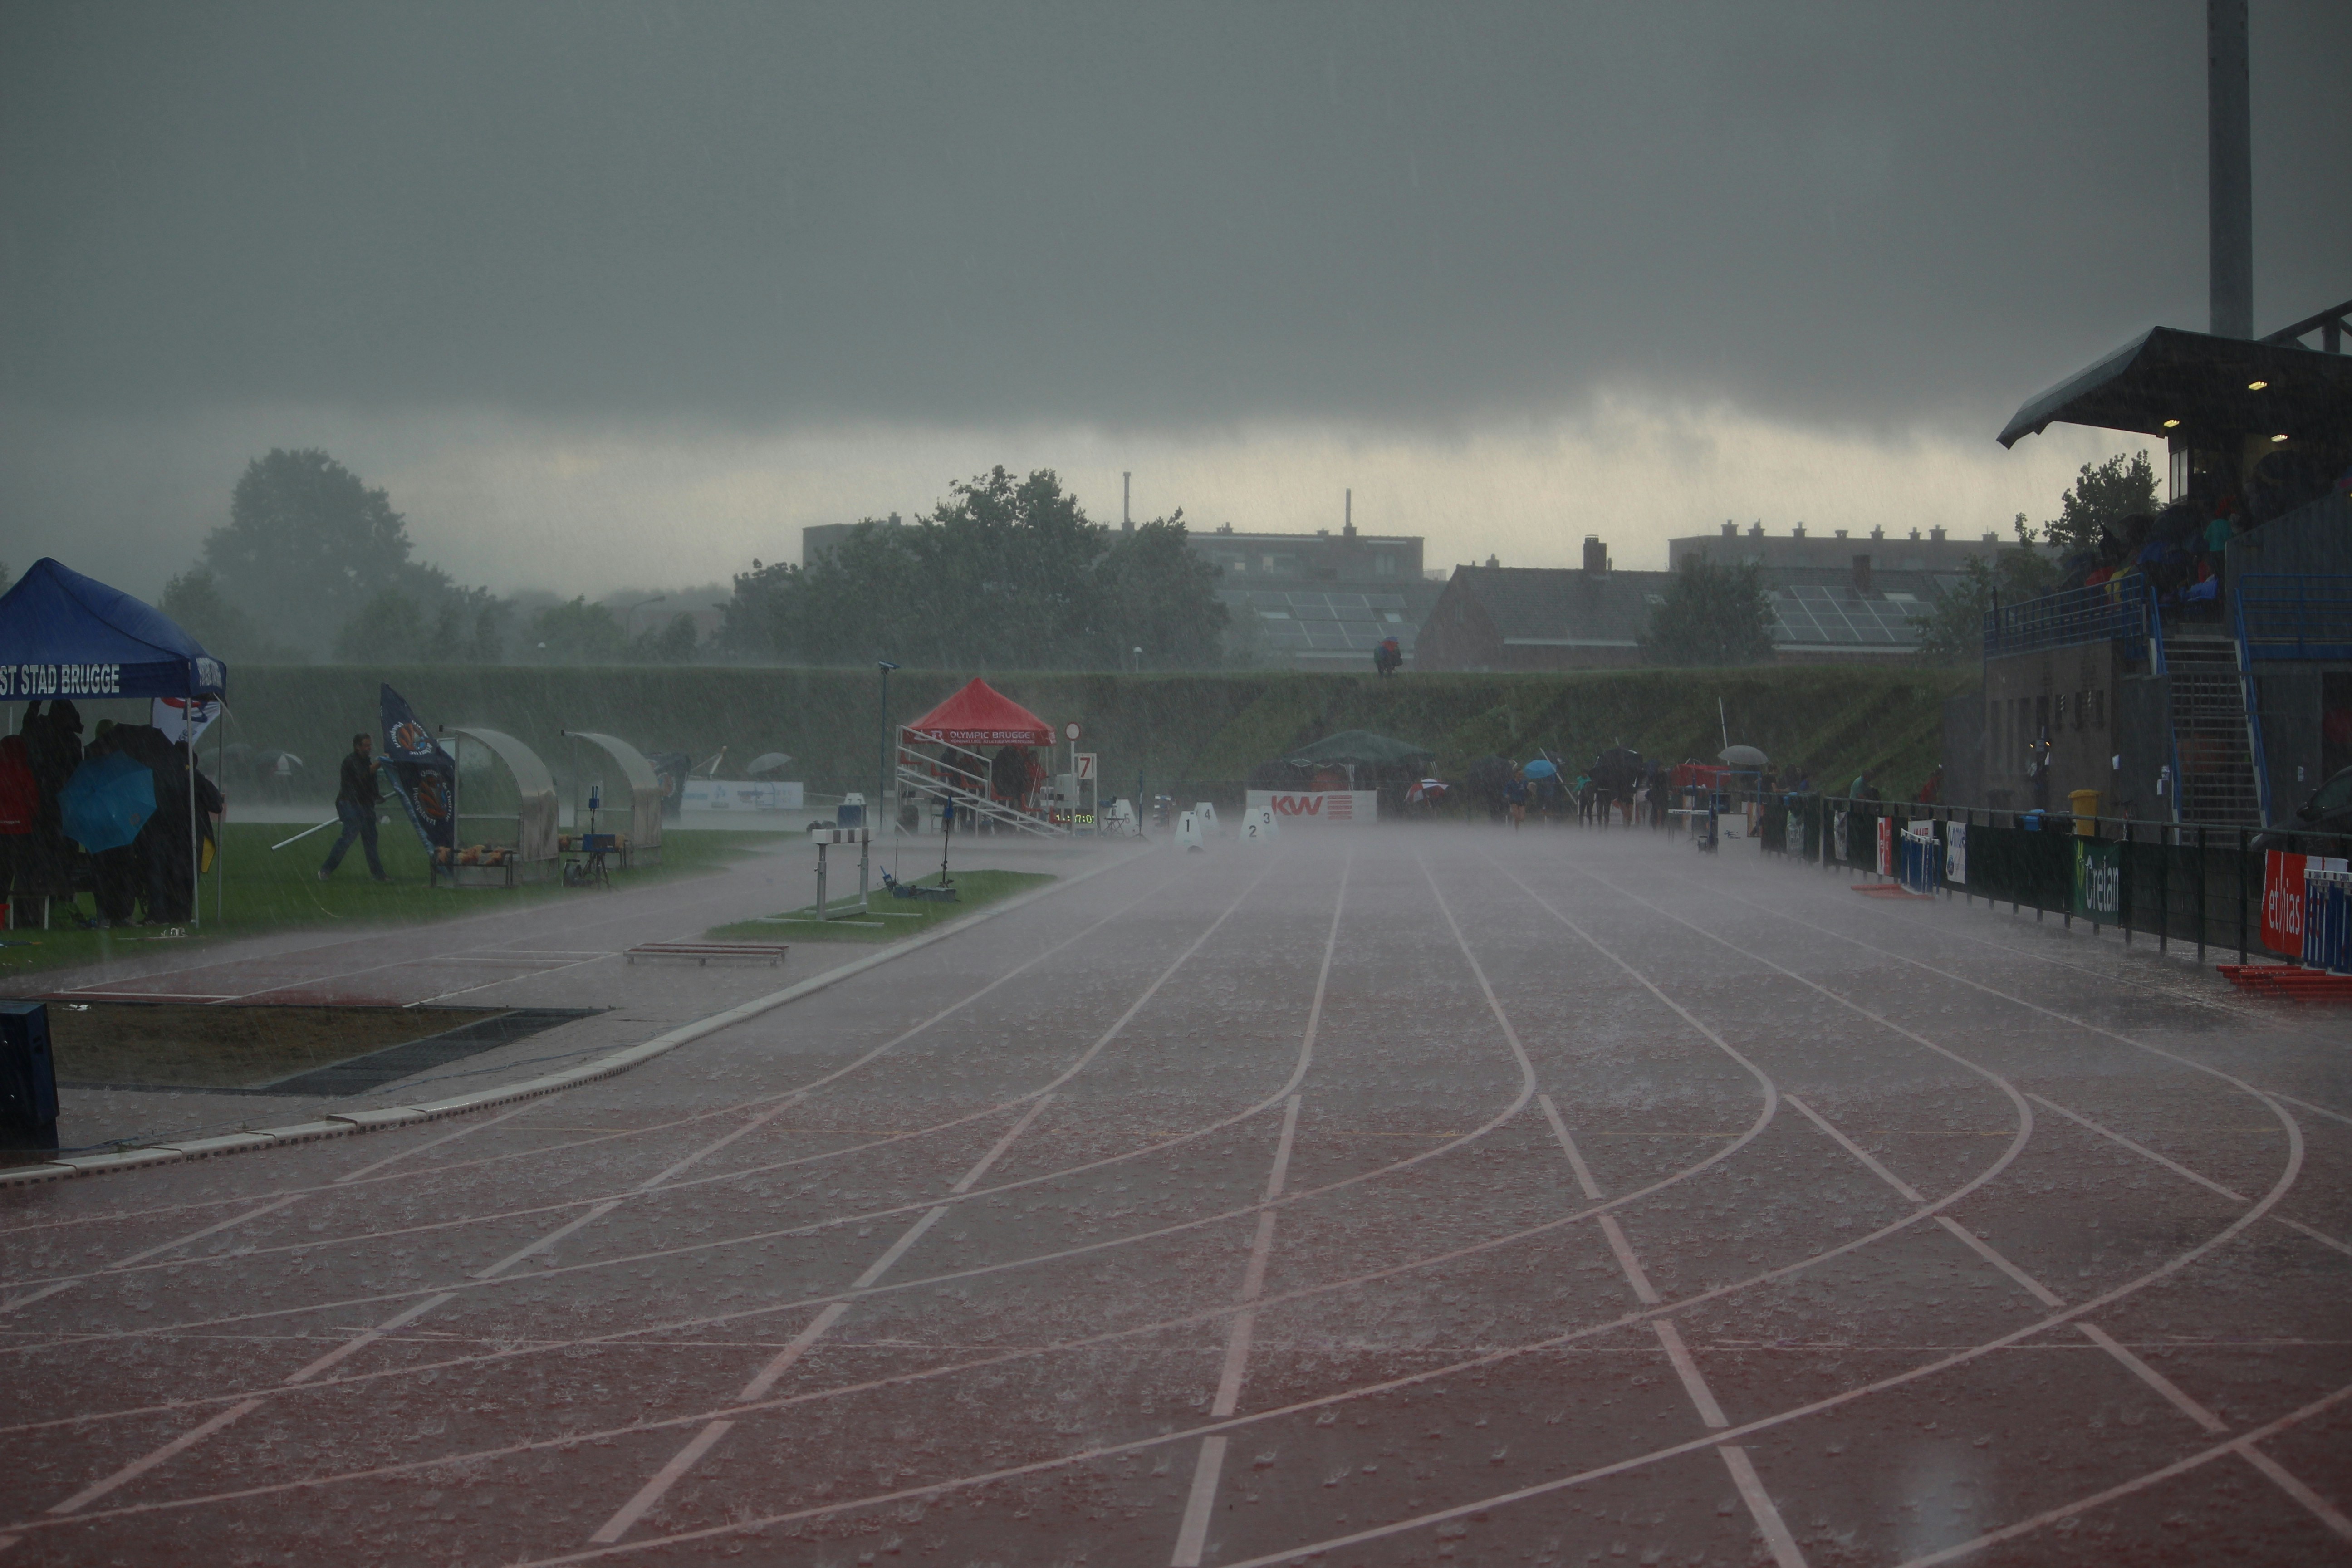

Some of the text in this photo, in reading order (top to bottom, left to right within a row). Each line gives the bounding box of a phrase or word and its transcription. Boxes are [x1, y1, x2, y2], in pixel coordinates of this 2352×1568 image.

[21, 664, 57, 695] STAD
[61, 663, 120, 694] BRUGGE
[1080, 757, 1091, 778] 7
[1123, 813, 1130, 824] 5
[1205, 809, 1210, 820] 4
[1263, 813, 1270, 824] 3
[1186, 819, 1190, 832] 1
[1249, 825, 1257, 838] 2
